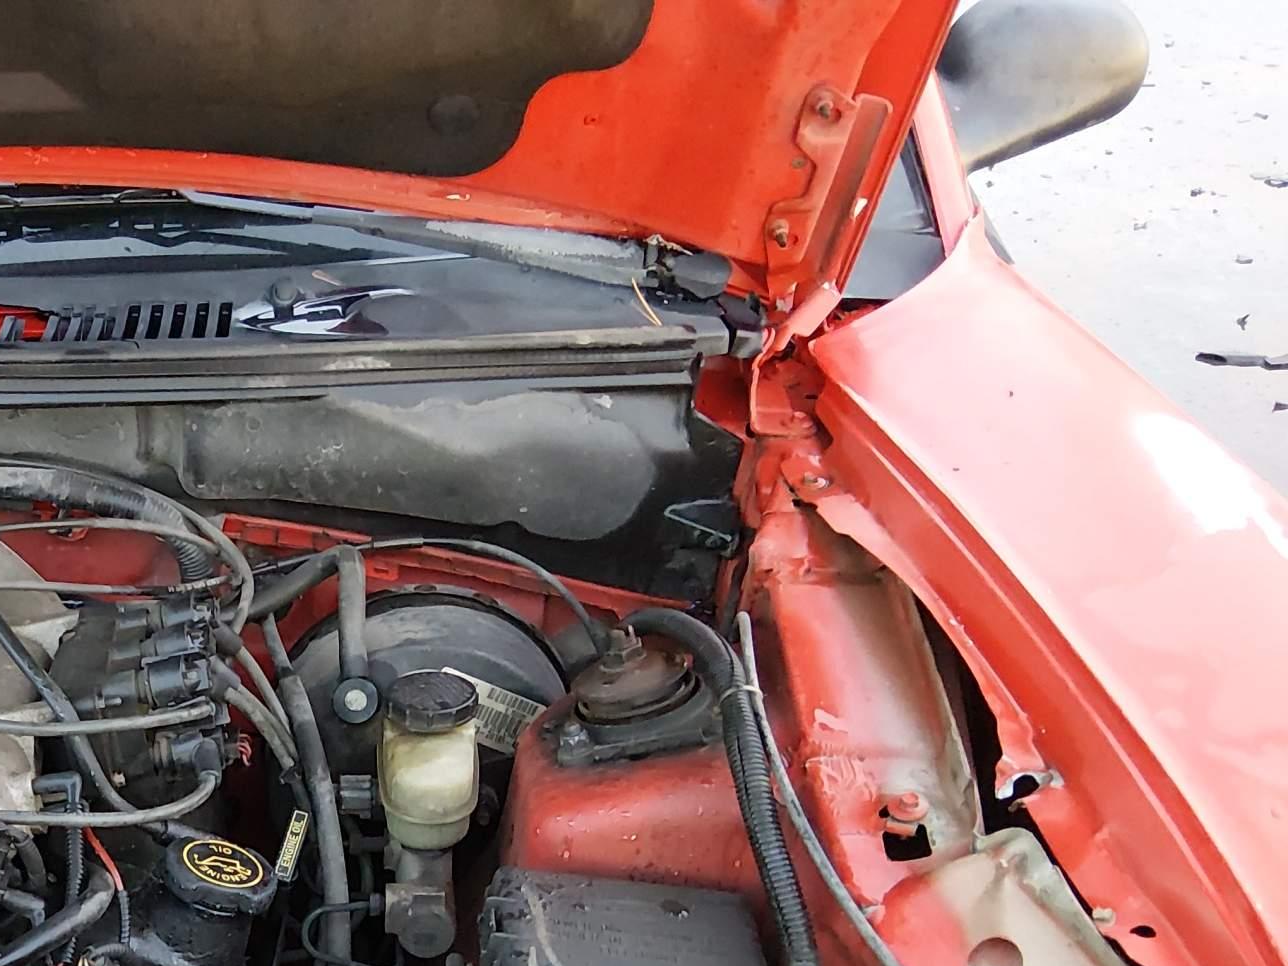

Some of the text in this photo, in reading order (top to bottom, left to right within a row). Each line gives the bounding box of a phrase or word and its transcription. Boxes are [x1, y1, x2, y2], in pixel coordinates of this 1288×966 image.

[208, 845, 232, 854] OIL
[281, 820, 304, 867] ENGINE OIL
[199, 865, 249, 882] ENGINE
